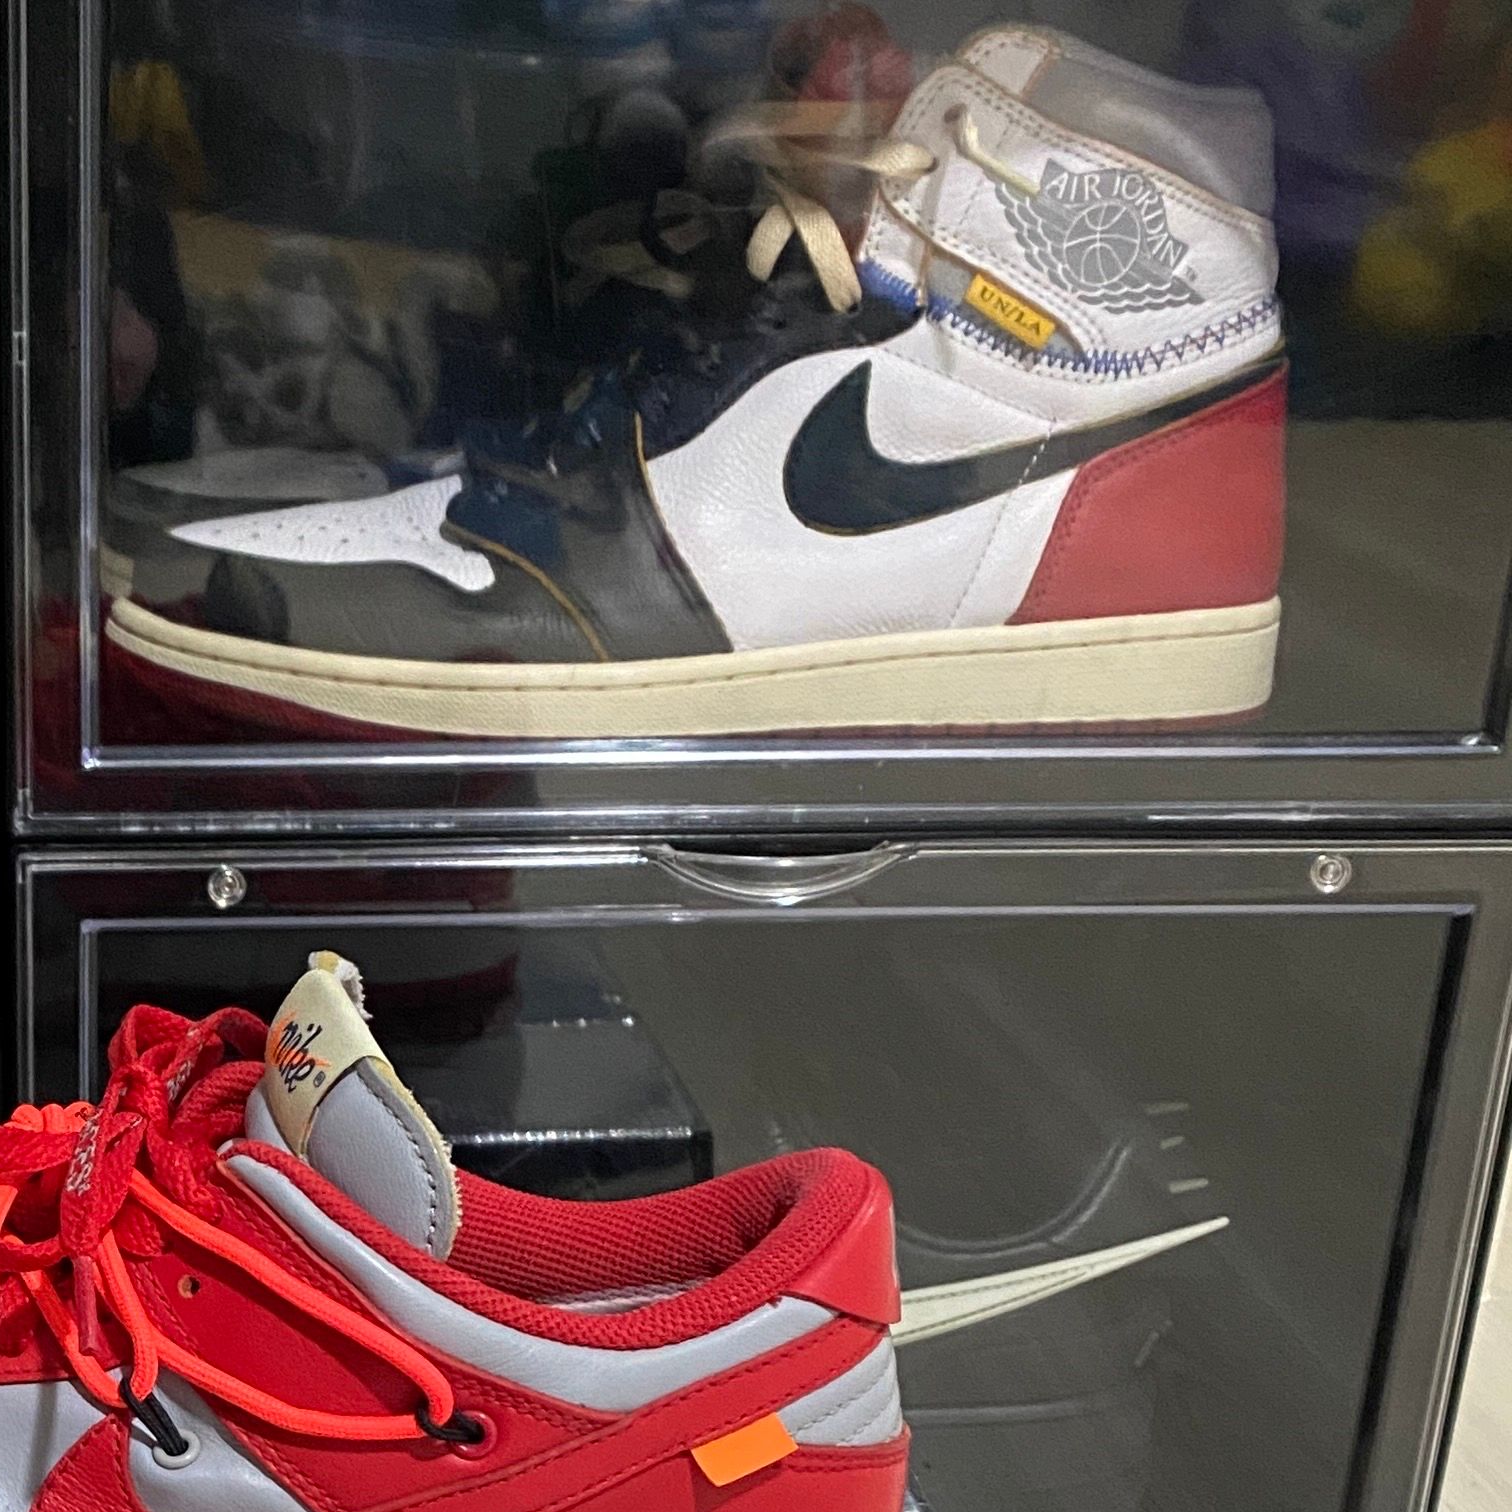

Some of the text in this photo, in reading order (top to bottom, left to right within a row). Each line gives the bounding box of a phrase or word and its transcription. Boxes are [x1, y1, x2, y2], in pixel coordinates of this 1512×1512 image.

[1045, 172, 1183, 269] AIR JORDAN
[979, 285, 1043, 337] UN/LA
